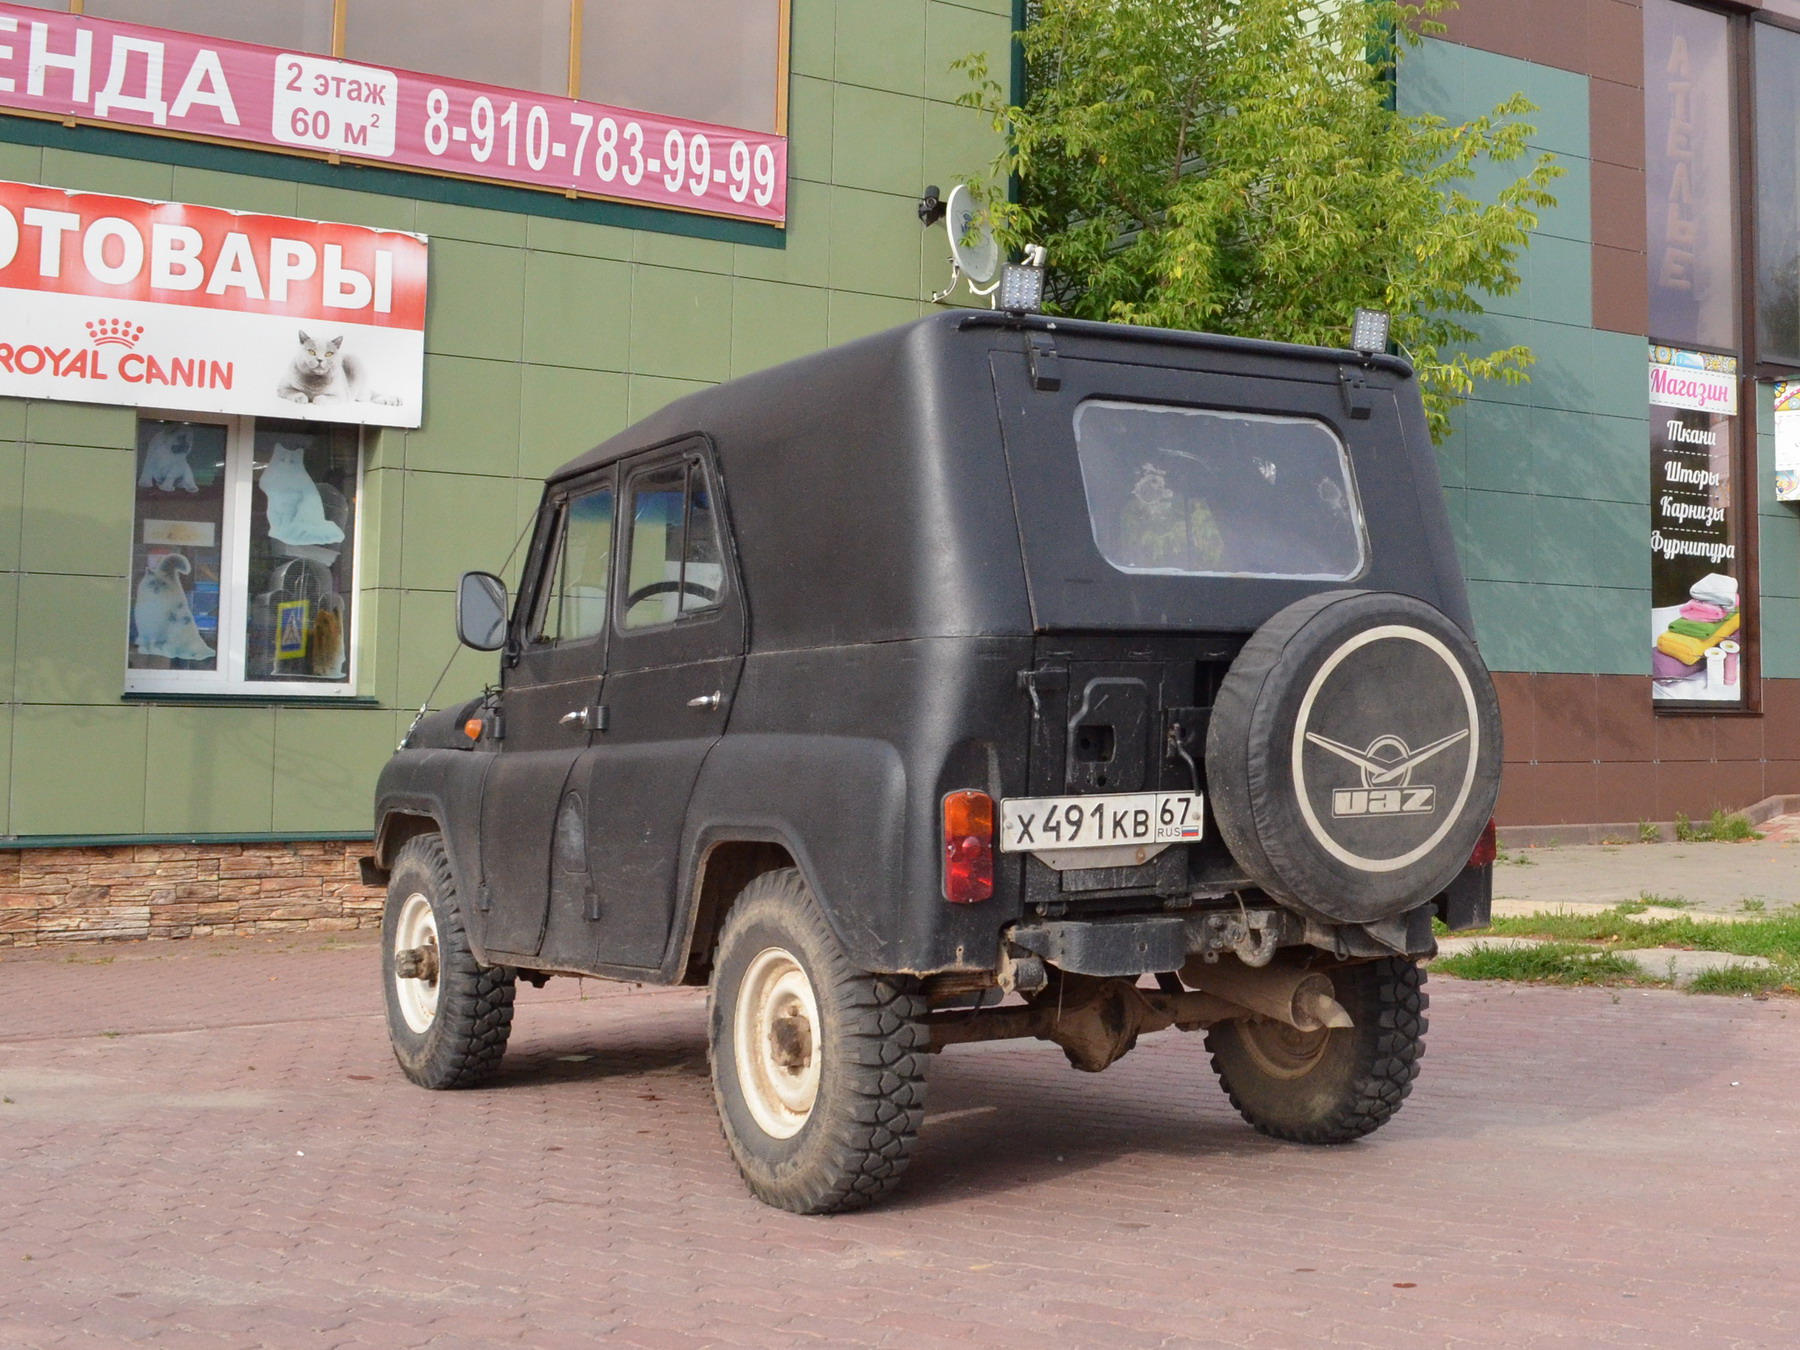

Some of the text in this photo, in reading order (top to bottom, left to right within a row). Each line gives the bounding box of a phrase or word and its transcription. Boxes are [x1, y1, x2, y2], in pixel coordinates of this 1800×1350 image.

[286, 62, 387, 106] 2 этаж
[290, 107, 330, 140] 60
[424, 88, 775, 206] 8-910-783-99-99
[118, 353, 233, 390] CANIN
[1650, 368, 1728, 407] Магазин
[1666, 420, 1717, 446] Ткани
[1664, 461, 1719, 490] Шторы
[1660, 495, 1725, 526] Карнизы
[1650, 530, 1735, 563] Фурнитура
[1159, 798, 1191, 825] 67
[1157, 827, 1180, 837] RUS
